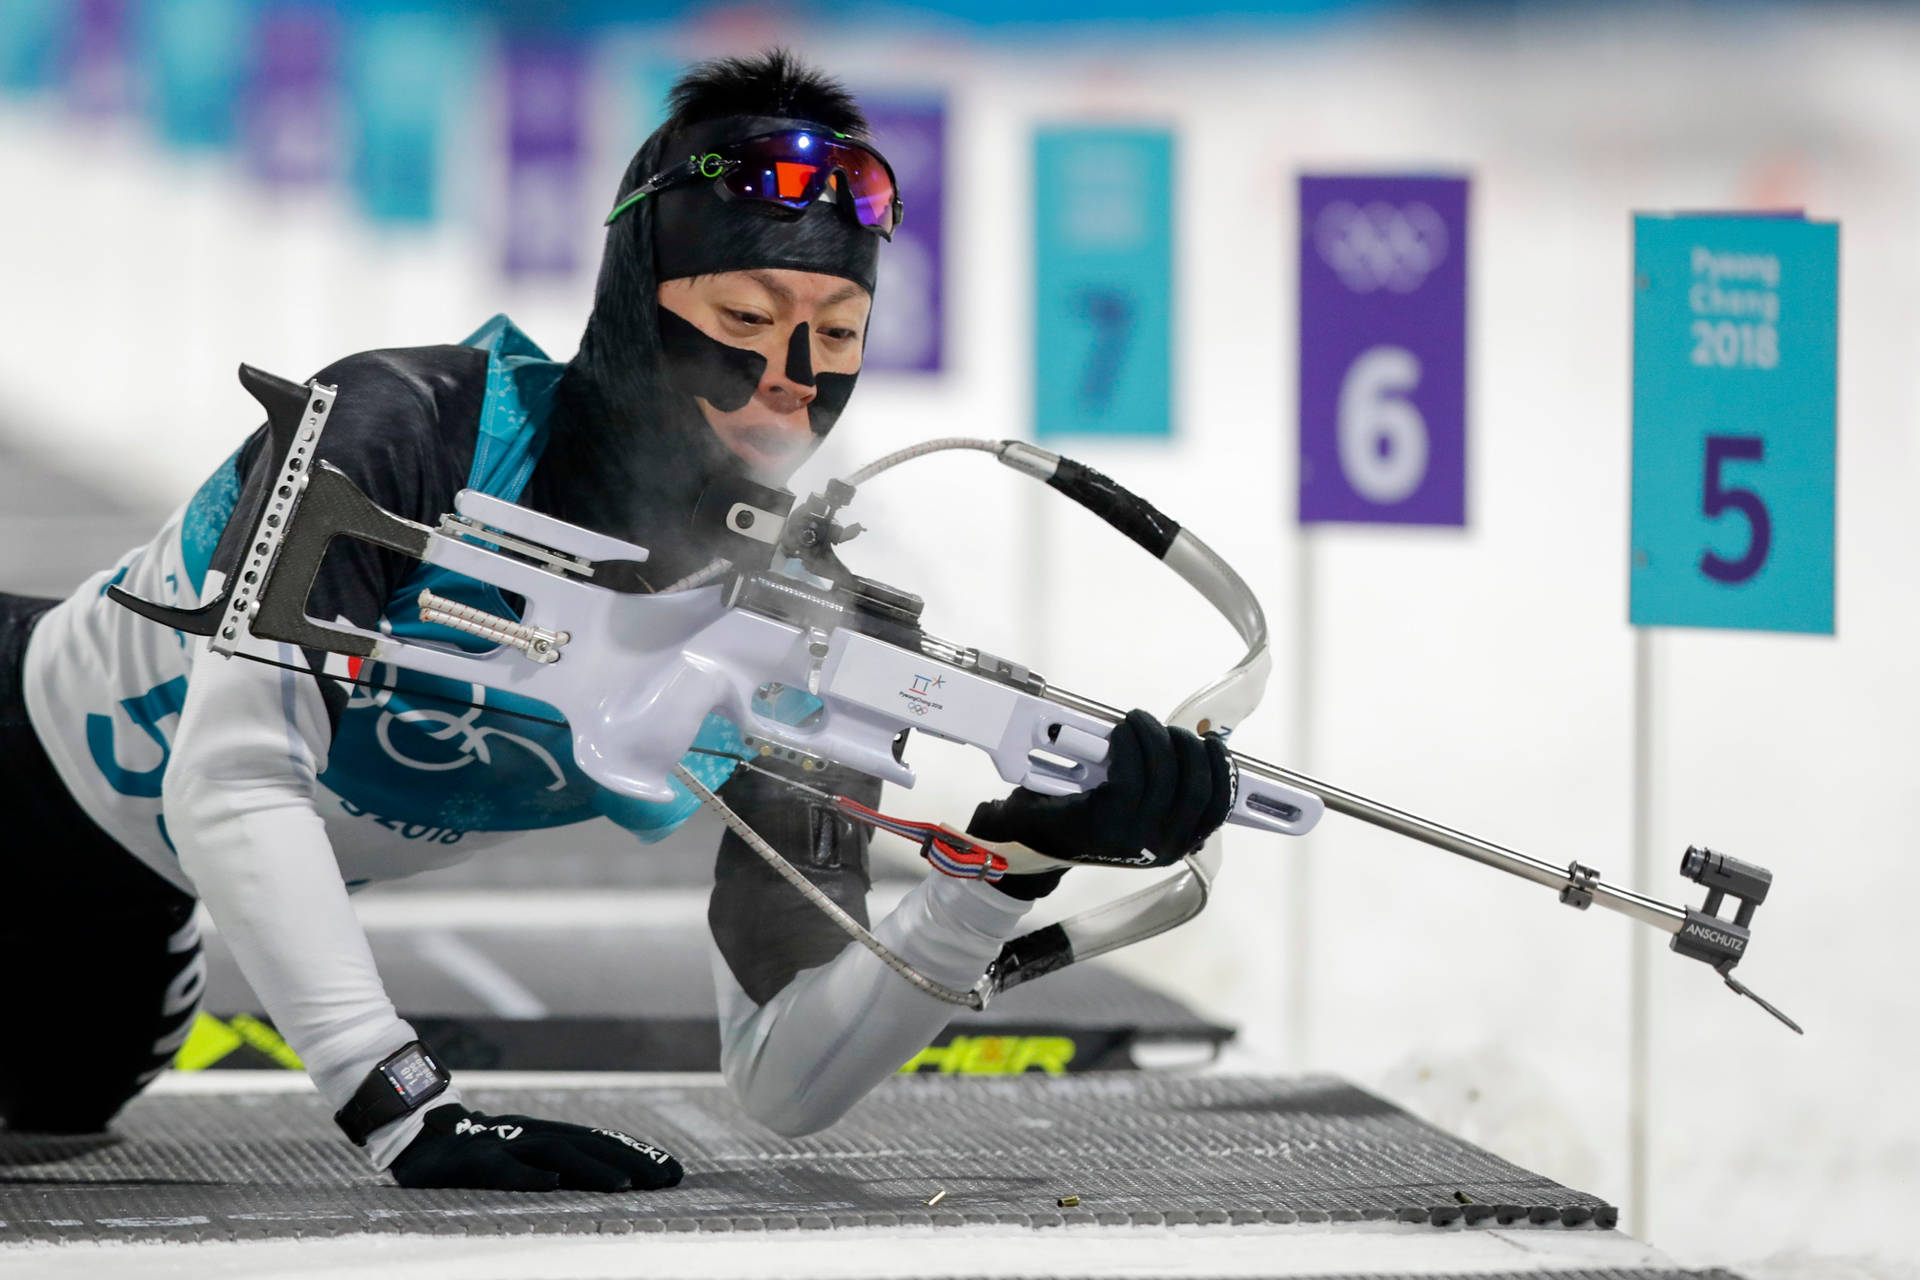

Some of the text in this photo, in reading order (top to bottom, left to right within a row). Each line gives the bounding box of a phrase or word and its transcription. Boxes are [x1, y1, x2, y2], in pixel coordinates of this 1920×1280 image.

[1690, 246, 1780, 287] Pyeong
[1689, 283, 1780, 322] Chang
[1071, 284, 1137, 416] 7
[1690, 320, 1779, 368] 2018
[1335, 344, 1430, 505] 6
[1699, 434, 1773, 586] 5
[1686, 923, 1744, 951] ANSCHUTZ
